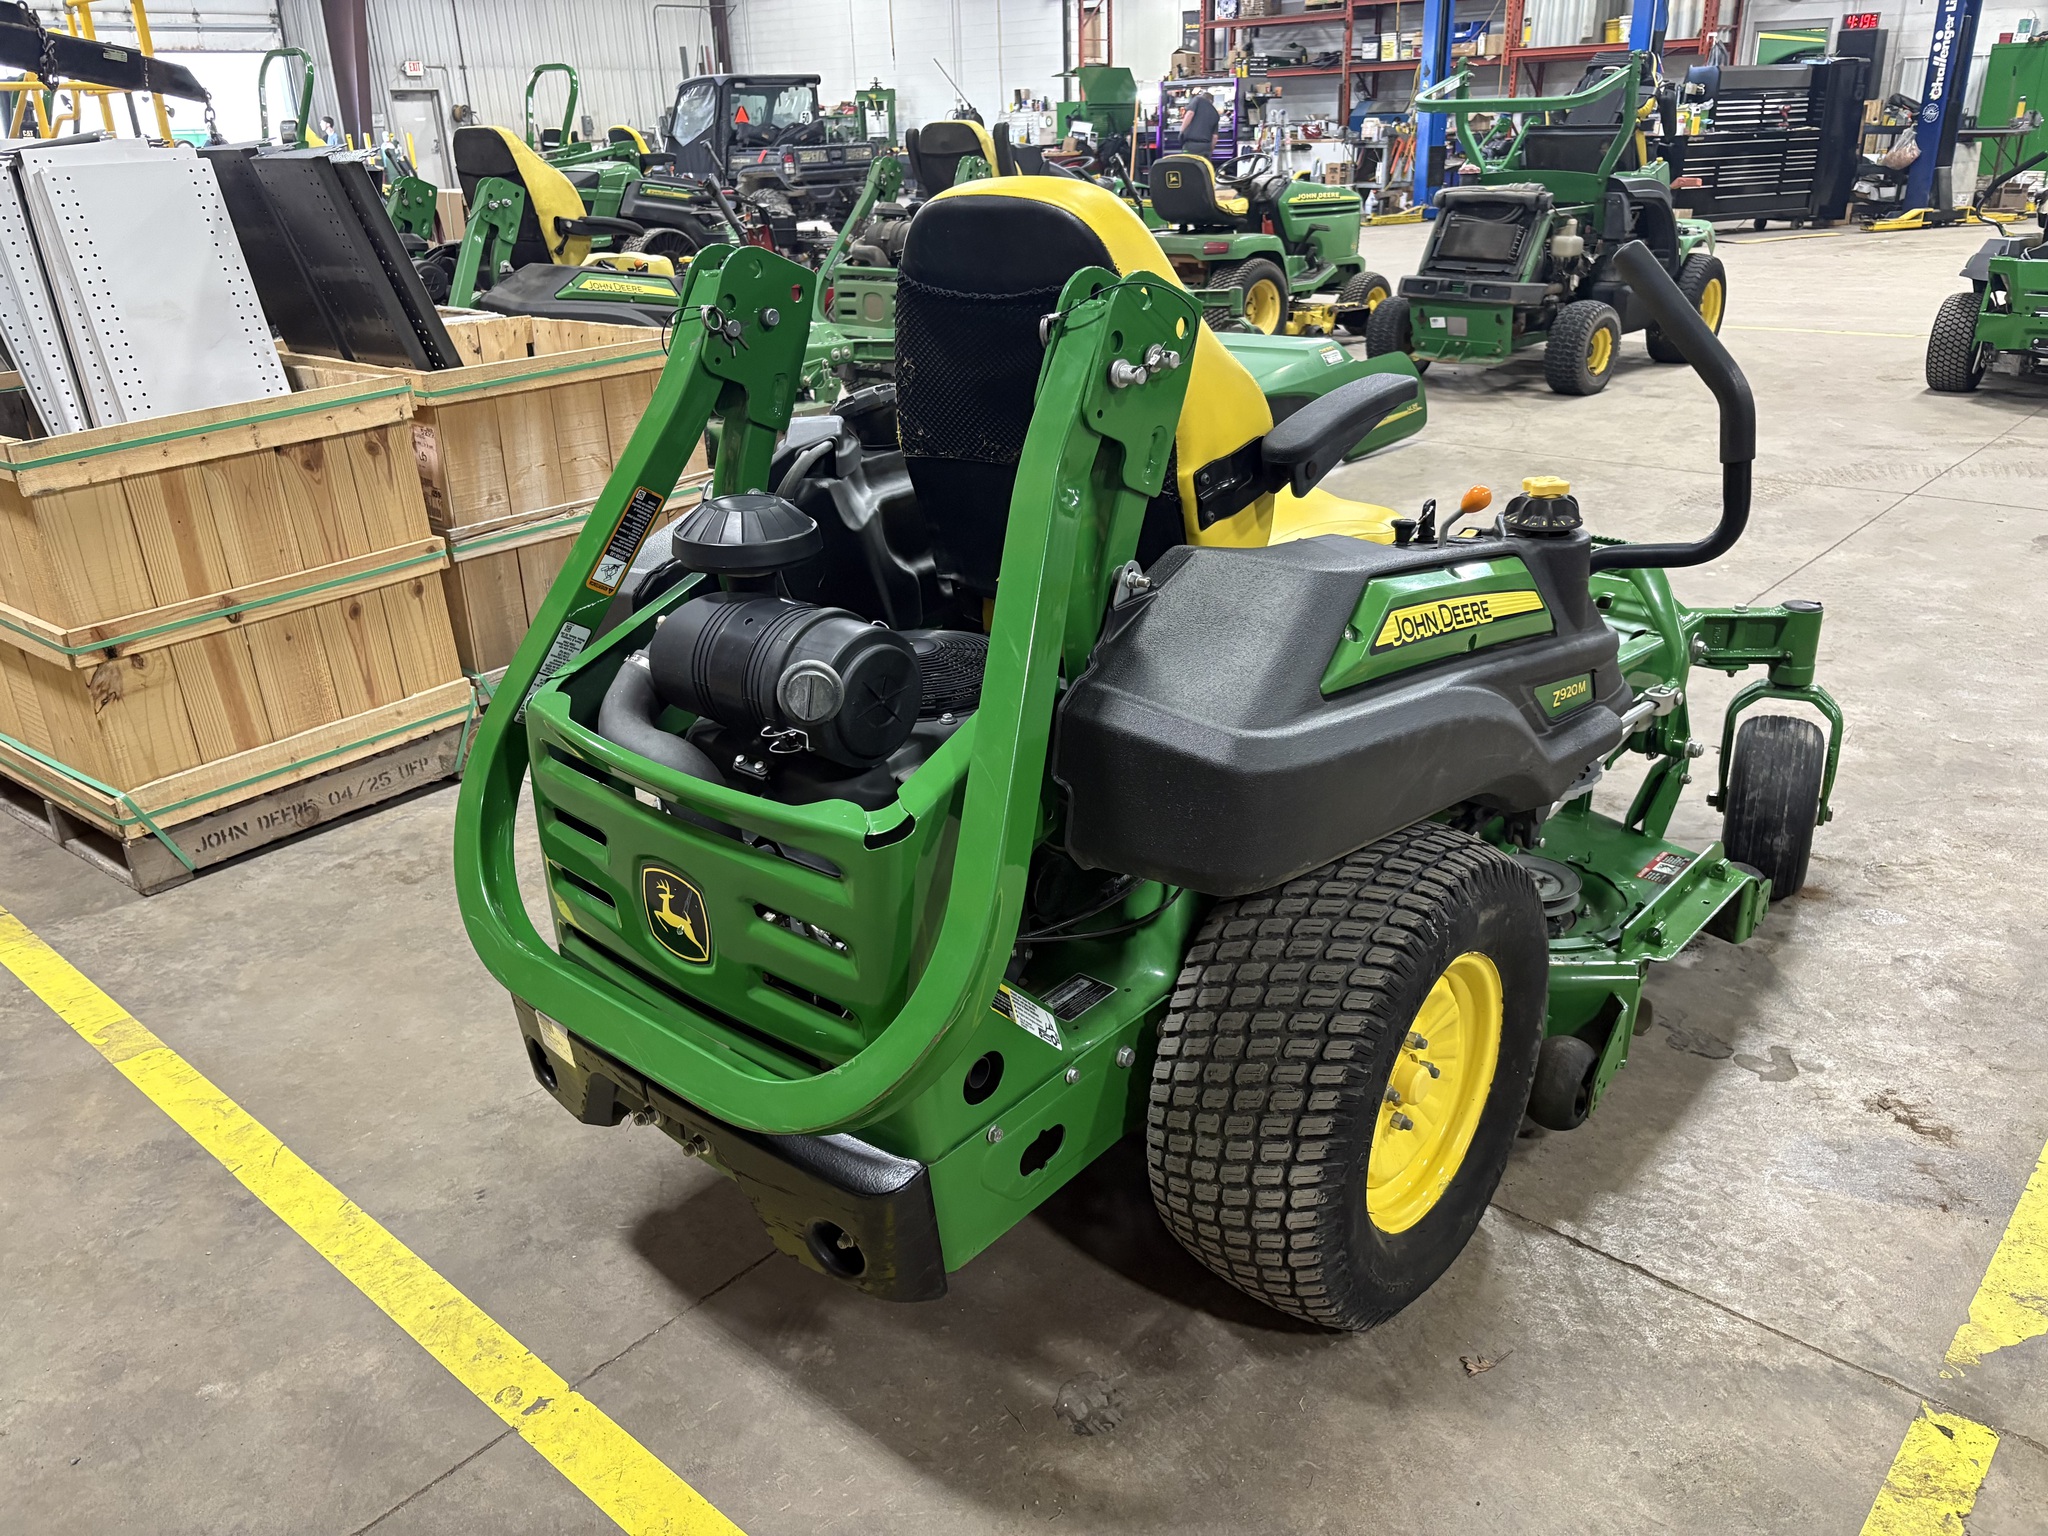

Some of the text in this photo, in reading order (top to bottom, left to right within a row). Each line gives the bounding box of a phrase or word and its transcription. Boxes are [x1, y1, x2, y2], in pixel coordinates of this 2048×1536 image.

[1846, 14, 1872, 29] 4:19
[1928, 14, 1955, 100] Challenger
[408, 61, 421, 72] EXIT
[801, 112, 810, 123] 50
[1296, 191, 1341, 201] JOHN DEERE
[588, 281, 644, 293] JOHN DEERE
[1393, 600, 1493, 643] JOHN DEERE
[1552, 680, 1587, 708] Z920M
[195, 757, 429, 853] JOHN DEERE 04/25 UFP
